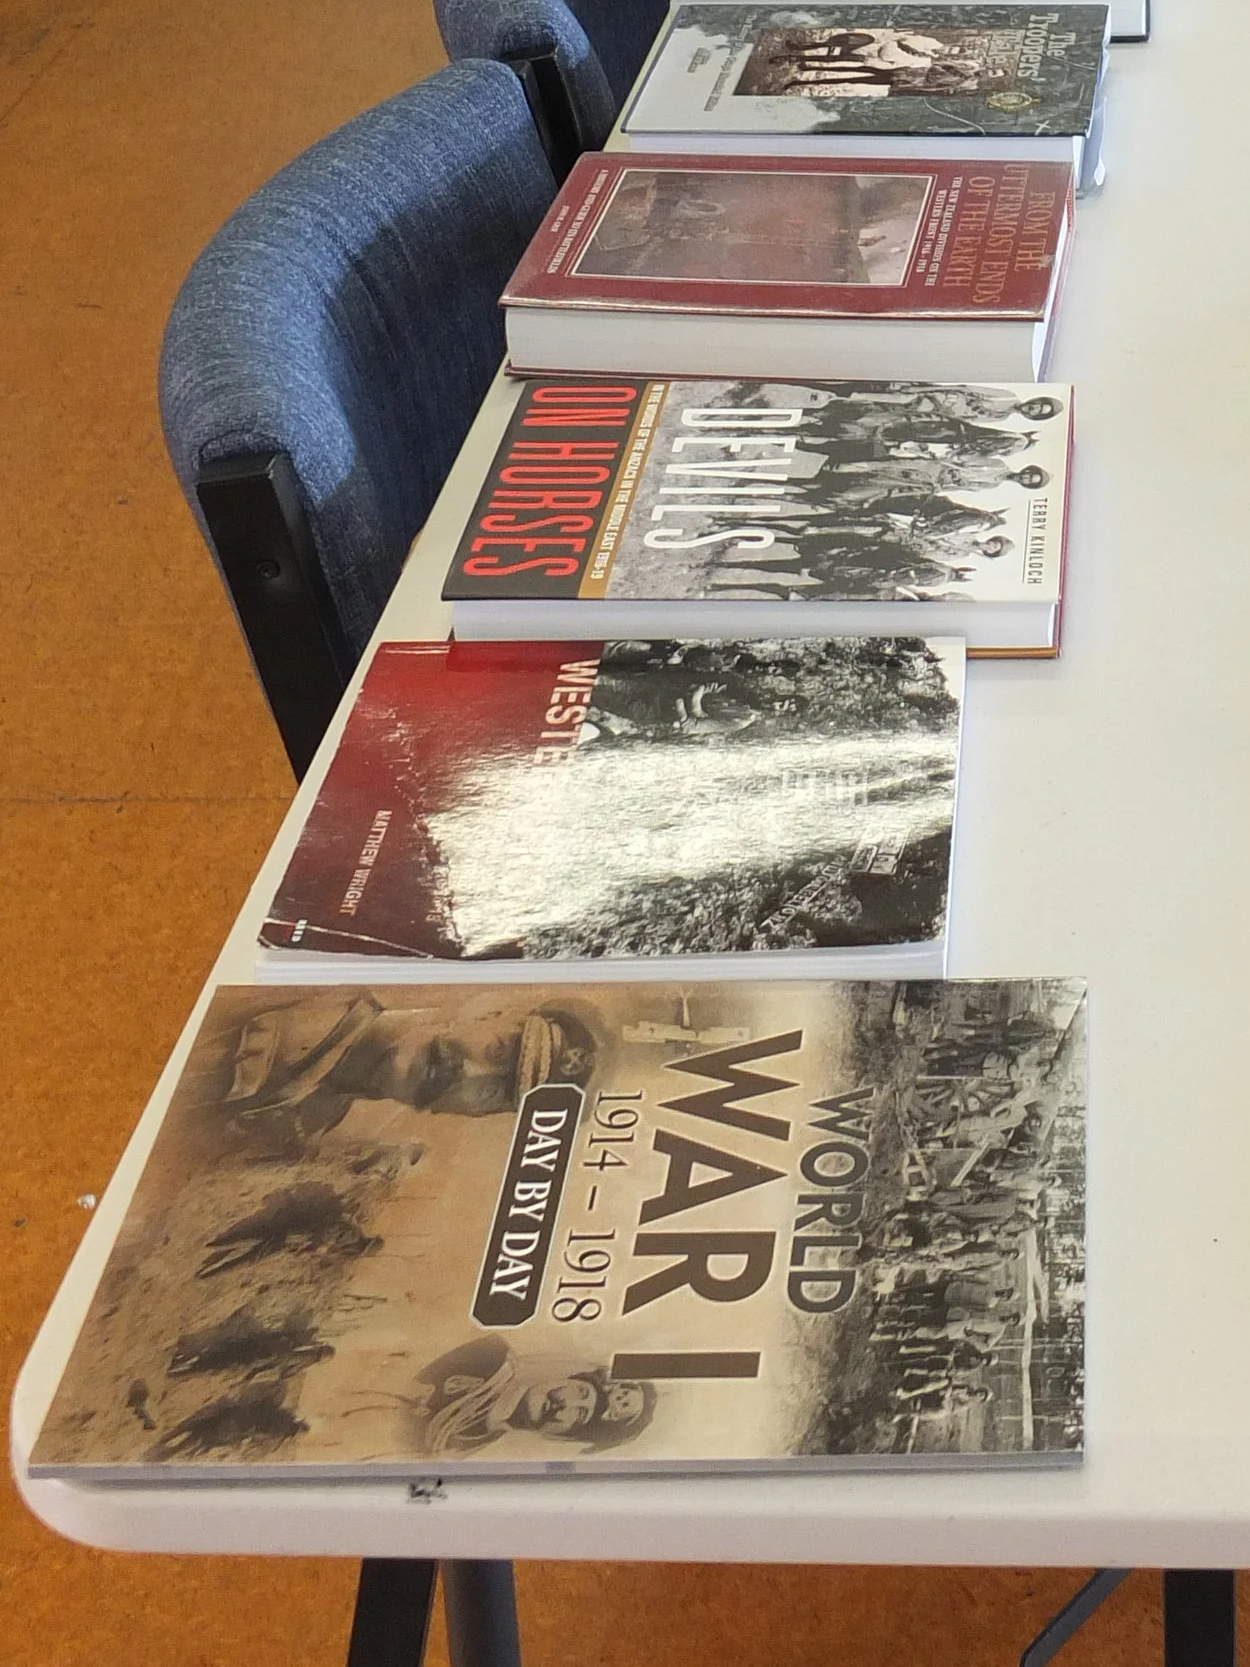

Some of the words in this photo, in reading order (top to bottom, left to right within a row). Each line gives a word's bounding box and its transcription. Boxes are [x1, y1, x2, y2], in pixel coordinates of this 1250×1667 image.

[1046, 32, 1077, 58] The
[956, 200, 990, 232] THE
[961, 176, 996, 206] OF
[981, 164, 1029, 254] UTTERMOST
[1022, 191, 1056, 233] FROM
[943, 233, 982, 287] EARTH
[972, 256, 1009, 304] ENDS
[1014, 237, 1046, 272] THE
[519, 385, 637, 428] ON
[642, 406, 804, 551] DEVILS
[462, 440, 620, 579] HORSES
[1029, 497, 1049, 534] TERRY
[1026, 537, 1044, 585] KINLOCH
[357, 806, 391, 863] MATTHEW
[338, 863, 372, 916] WRIGHT
[518, 1107, 569, 1170] DAY
[583, 1088, 644, 1173] 1914
[619, 1027, 805, 1318] WAR
[506, 1177, 551, 1223] BY
[784, 1085, 875, 1314] WORLD
[486, 1229, 540, 1302] DAY
[551, 1227, 616, 1324] 1918
[611, 1349, 761, 1383] I
